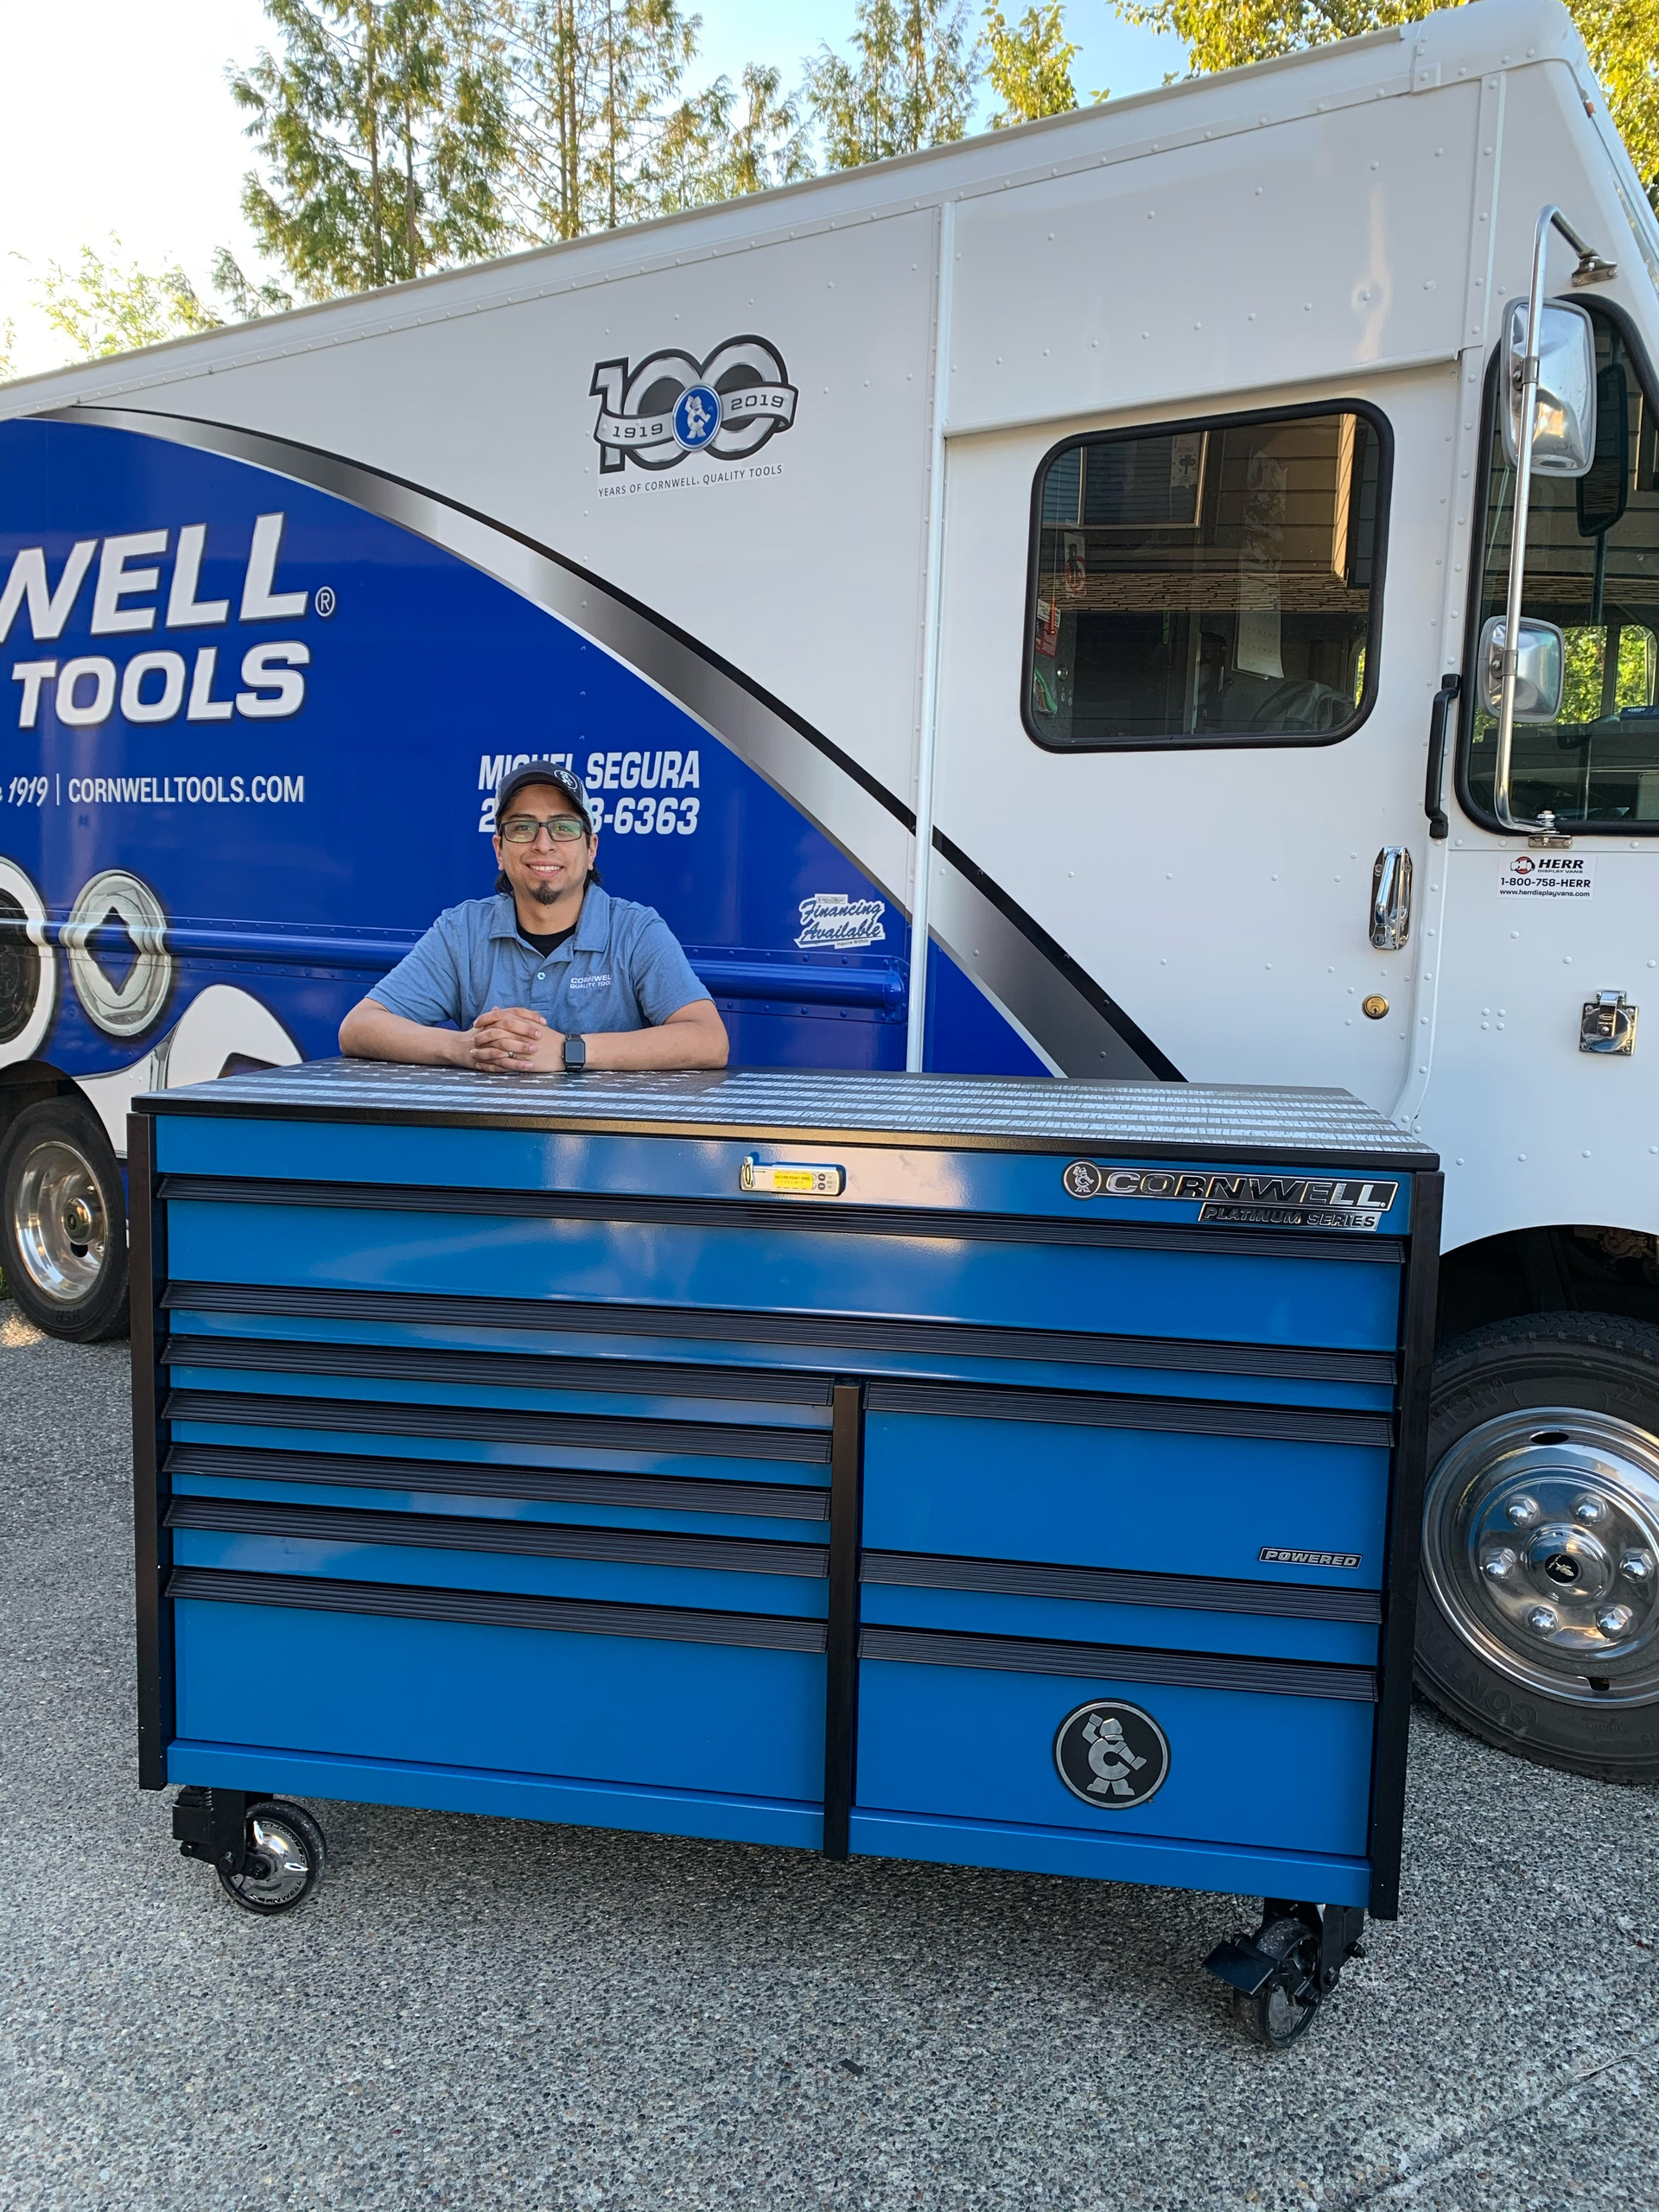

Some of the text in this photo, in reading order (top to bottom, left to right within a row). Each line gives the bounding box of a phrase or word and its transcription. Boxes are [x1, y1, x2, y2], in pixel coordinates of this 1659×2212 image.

[731, 394, 785, 410] 2019
[612, 423, 664, 438] 1919
[598, 486, 626, 497] YEARS
[629, 484, 642, 493] OF
[702, 470, 746, 485] QUALITY
[749, 465, 783, 478] TOOLS
[11, 640, 310, 728] TOOLS
[585, 750, 701, 789] SEGURA
[8, 776, 48, 807] 1919
[68, 775, 304, 803] CORNWELLTOOLS.COM
[1538, 859, 1585, 869] HERR
[1501, 878, 1591, 887] 1-800-758-HERR
[801, 900, 882, 922] Financing
[799, 918, 881, 944] Available
[1104, 1171, 1382, 1208] CORNWELL
[1204, 1206, 1376, 1227] PLATINUM SERIES
[1264, 1550, 1357, 1567] POWERED
